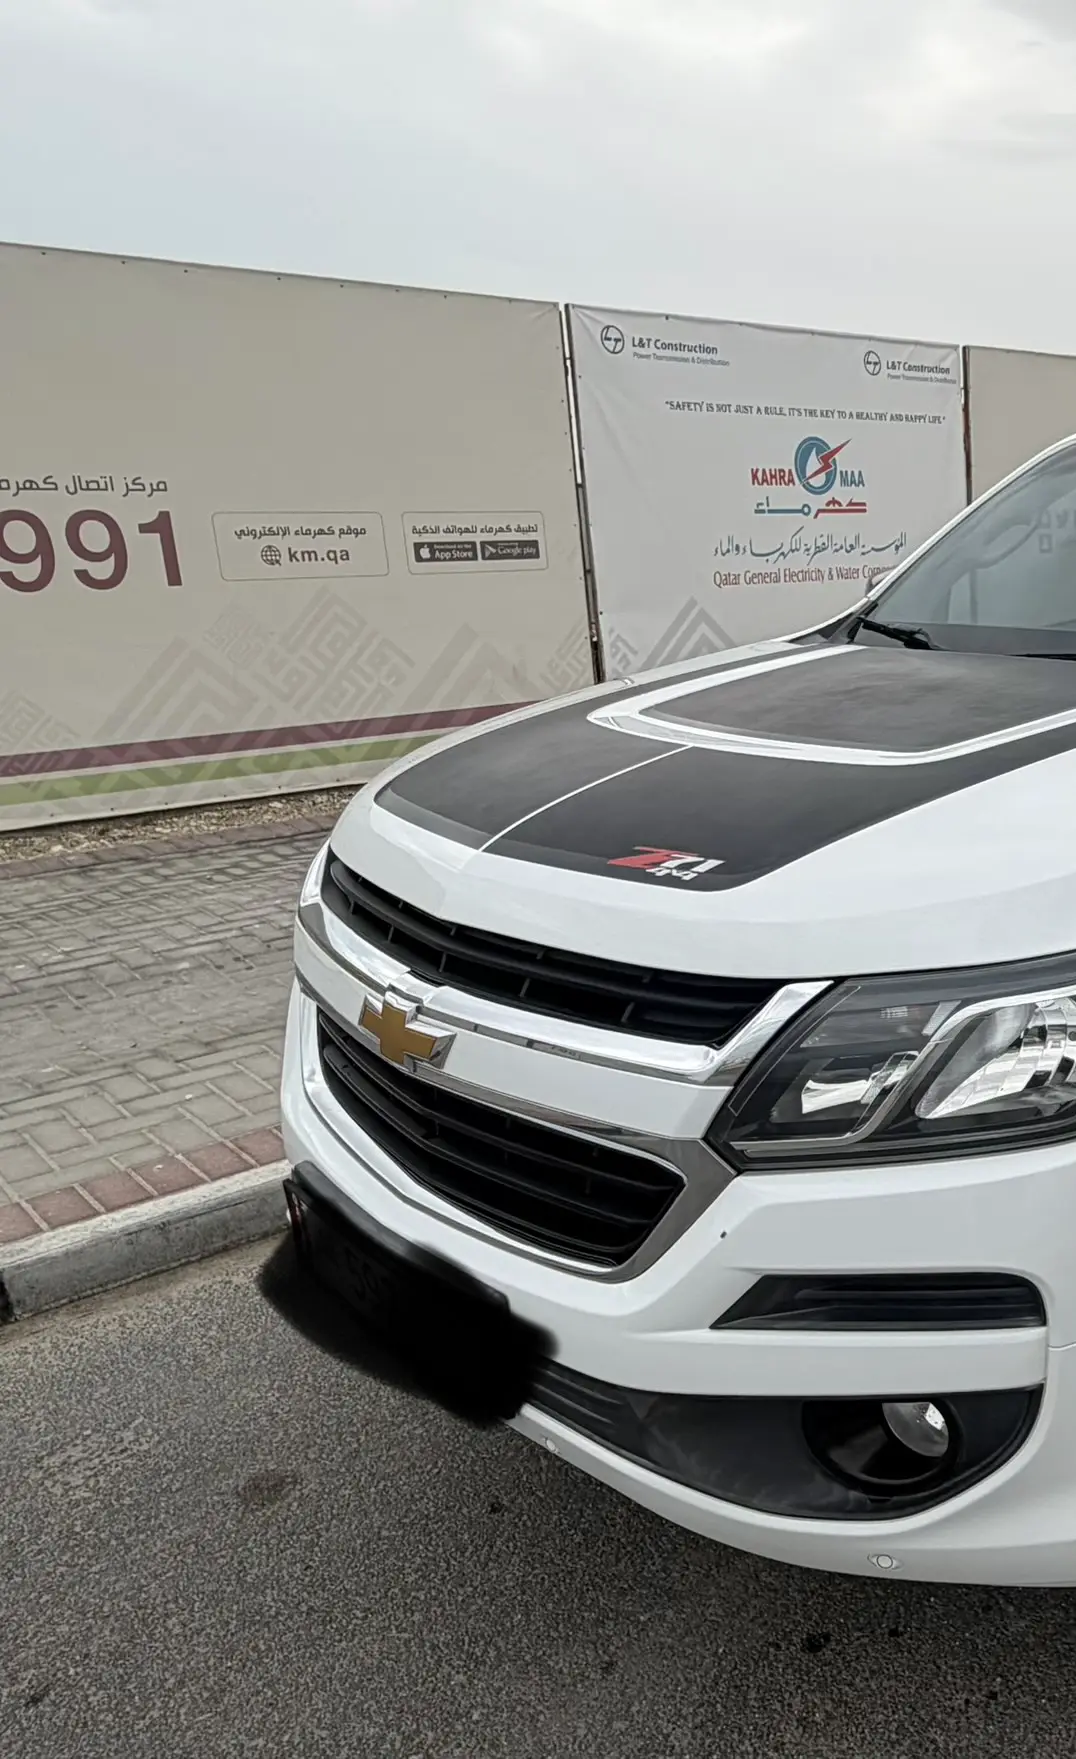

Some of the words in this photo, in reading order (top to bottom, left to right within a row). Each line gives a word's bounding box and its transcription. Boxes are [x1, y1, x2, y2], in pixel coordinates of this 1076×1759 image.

[632, 336, 652, 348] L&T
[654, 338, 718, 355] Construction
[886, 360, 902, 370] L&T
[903, 361, 950, 374] Construction
[706, 403, 714, 413] IS
[716, 403, 732, 413] NOT
[734, 404, 753, 415] JUST
[756, 405, 762, 415] A
[803, 408, 818, 418] THE
[820, 409, 835, 419] KEY
[837, 410, 846, 419] TO
[848, 411, 854, 420] A
[855, 412, 888, 421] HEALTHY
[889, 413, 903, 422] AND
[904, 413, 927, 423] HAPPY
[65, 475, 114, 496] اتصال
[750, 468, 796, 486] KAHRA
[839, 470, 865, 487] MAA
[122, 476, 168, 498] مركز
[234, 526, 291, 540] الإلكتروني
[294, 526, 335, 540] كهرماء
[338, 526, 367, 539] موقع
[412, 525, 440, 537] الذكية
[442, 524, 477, 536] للهواتف
[480, 524, 512, 536] كهرماء
[514, 524, 538, 535] تطبيق
[0, 509, 183, 593] 991
[497, 546, 522, 557] Google
[803, 532, 833, 566] القطرية
[833, 533, 860, 555] العامة
[288, 547, 350, 565] km.qa
[434, 550, 451, 560] App
[451, 550, 473, 558] Store
[713, 570, 741, 589] Qatar
[744, 567, 780, 585] General
[784, 567, 825, 584] Electricity
[828, 569, 834, 581] &
[836, 565, 860, 580] Water
